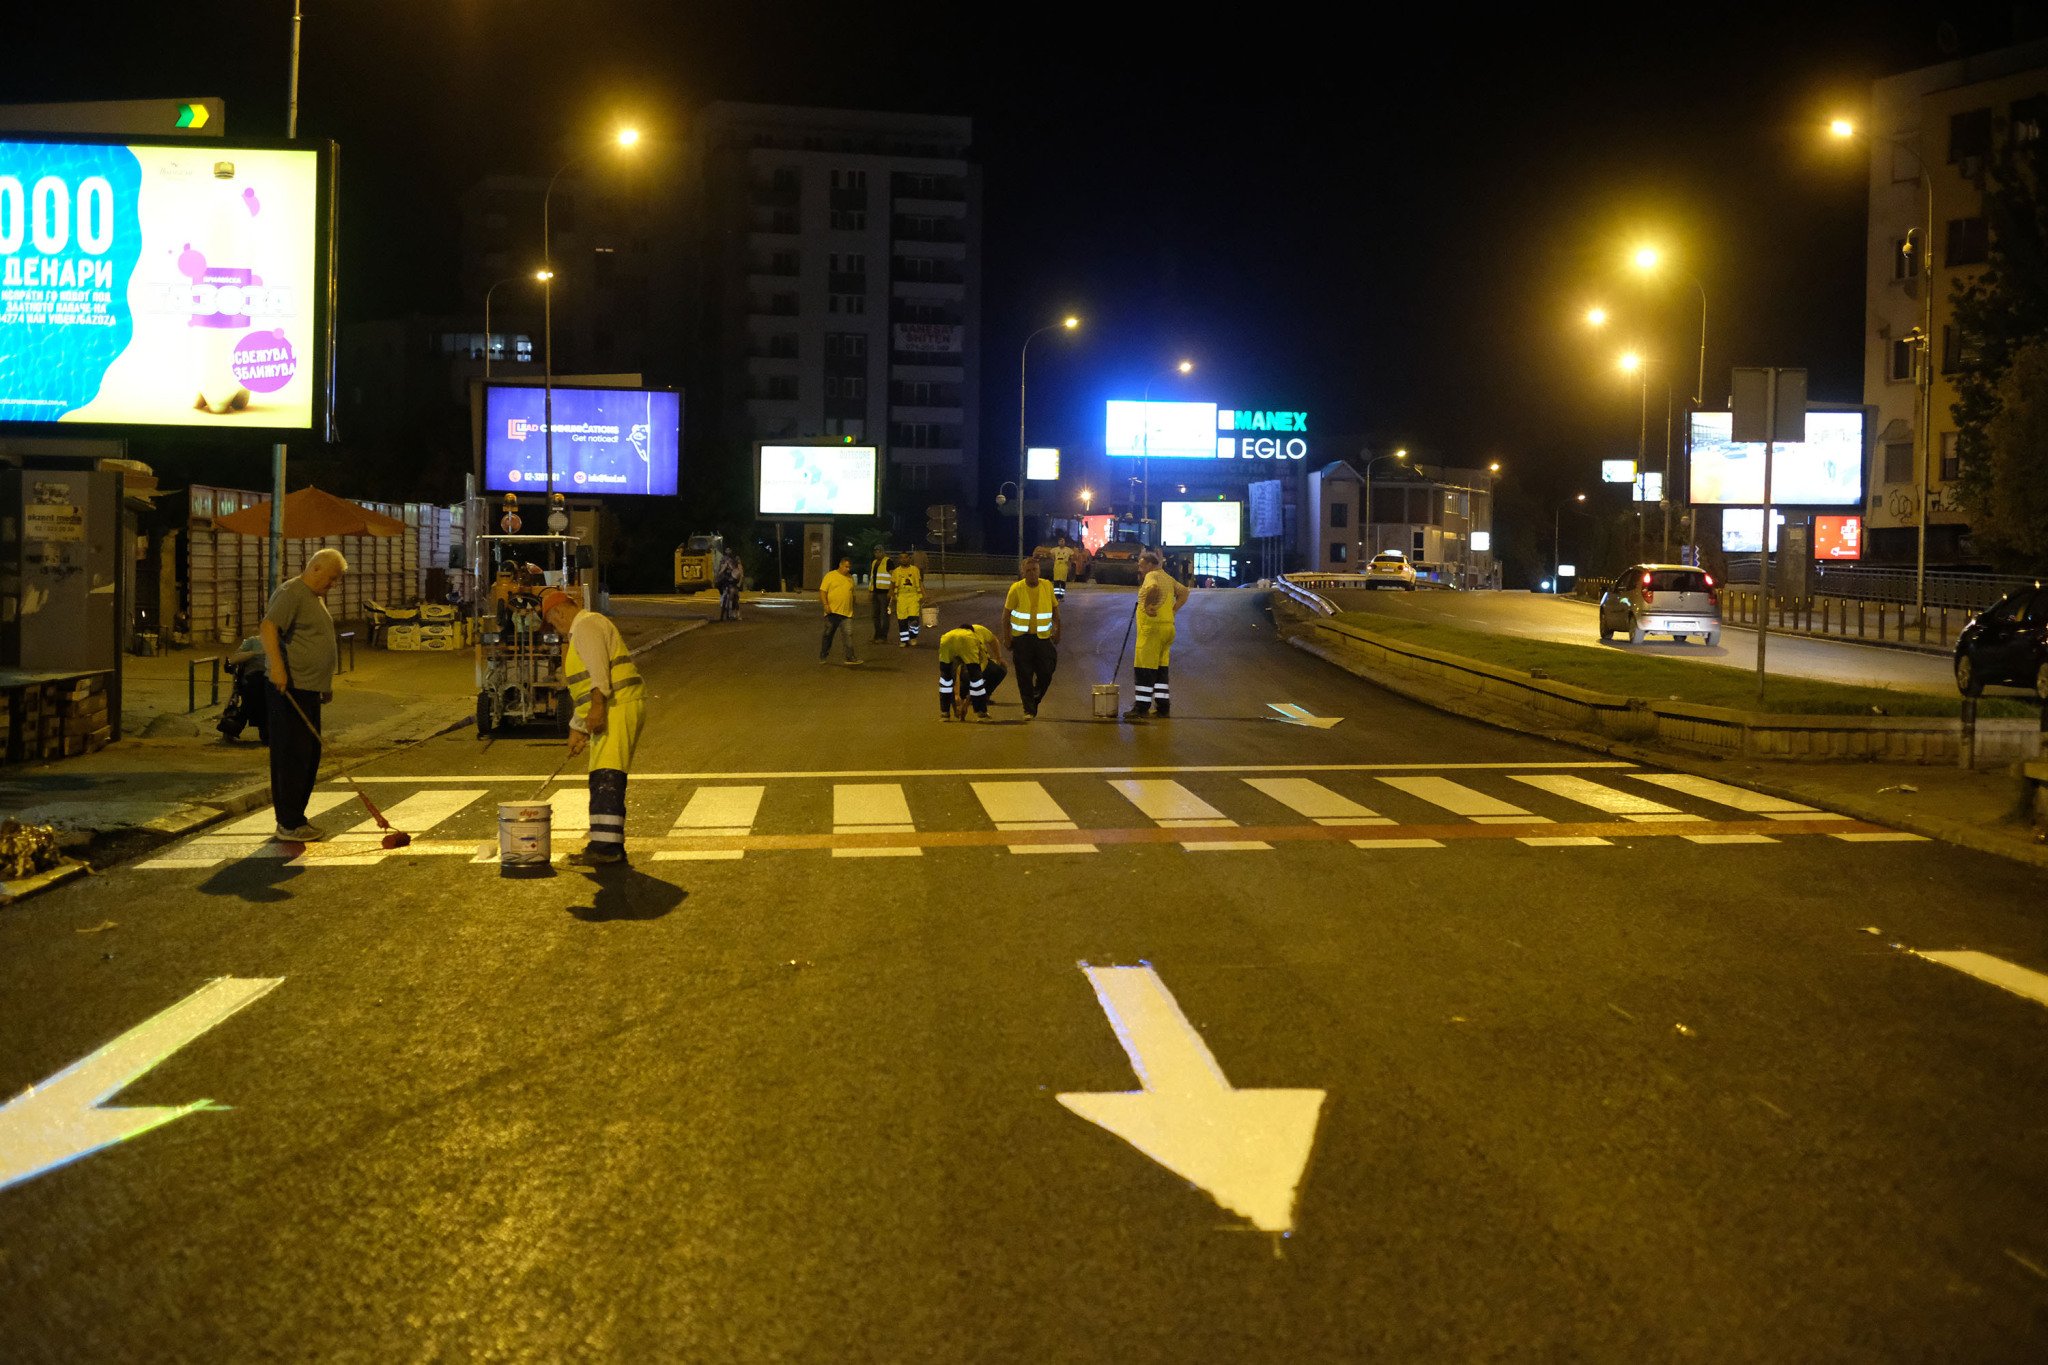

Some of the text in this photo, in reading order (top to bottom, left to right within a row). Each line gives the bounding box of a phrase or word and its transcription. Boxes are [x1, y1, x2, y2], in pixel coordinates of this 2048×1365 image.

[2, 256, 113, 289] ДЕНАРИ
[233, 347, 289, 365] СВЕЖУВА
[516, 423, 620, 434] LEAD CMMUNICATIONS
[1234, 410, 1308, 432] MANEX
[572, 434, 619, 443] Get noticed!
[1242, 438, 1307, 460] EGLO
[682, 565, 702, 578] CAT
